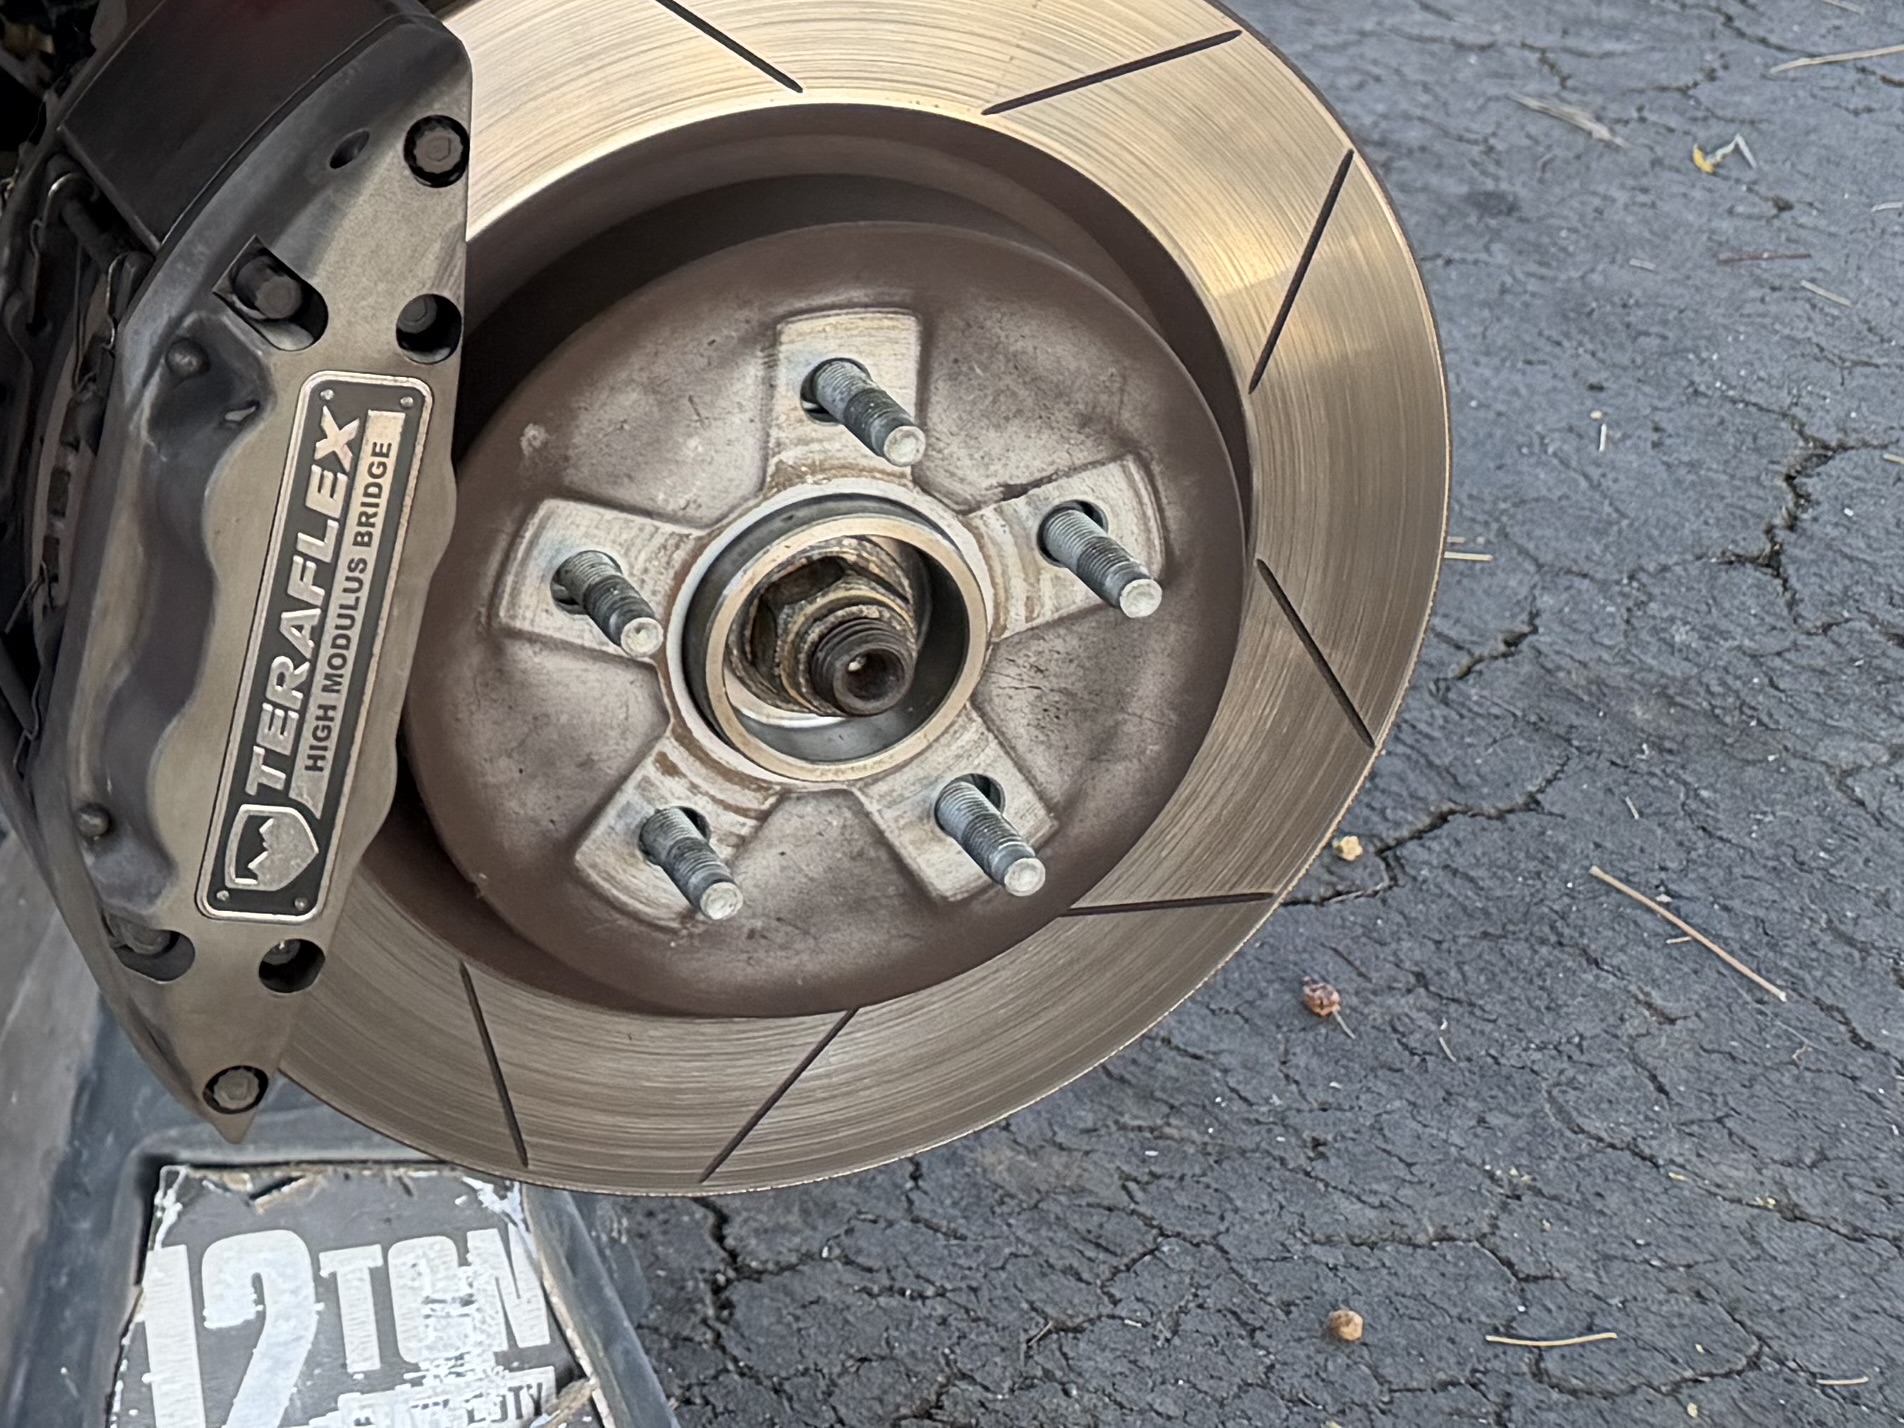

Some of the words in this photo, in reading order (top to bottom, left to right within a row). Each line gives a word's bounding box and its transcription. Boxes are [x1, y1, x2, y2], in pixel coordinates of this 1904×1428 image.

[245, 405, 360, 796] TERAFLEX
[304, 703, 337, 773] HIGH
[321, 556, 368, 694] MODULUS
[352, 441, 392, 547] BRIDGE
[142, 1229, 317, 1428] 12
[319, 1223, 551, 1373] TON
